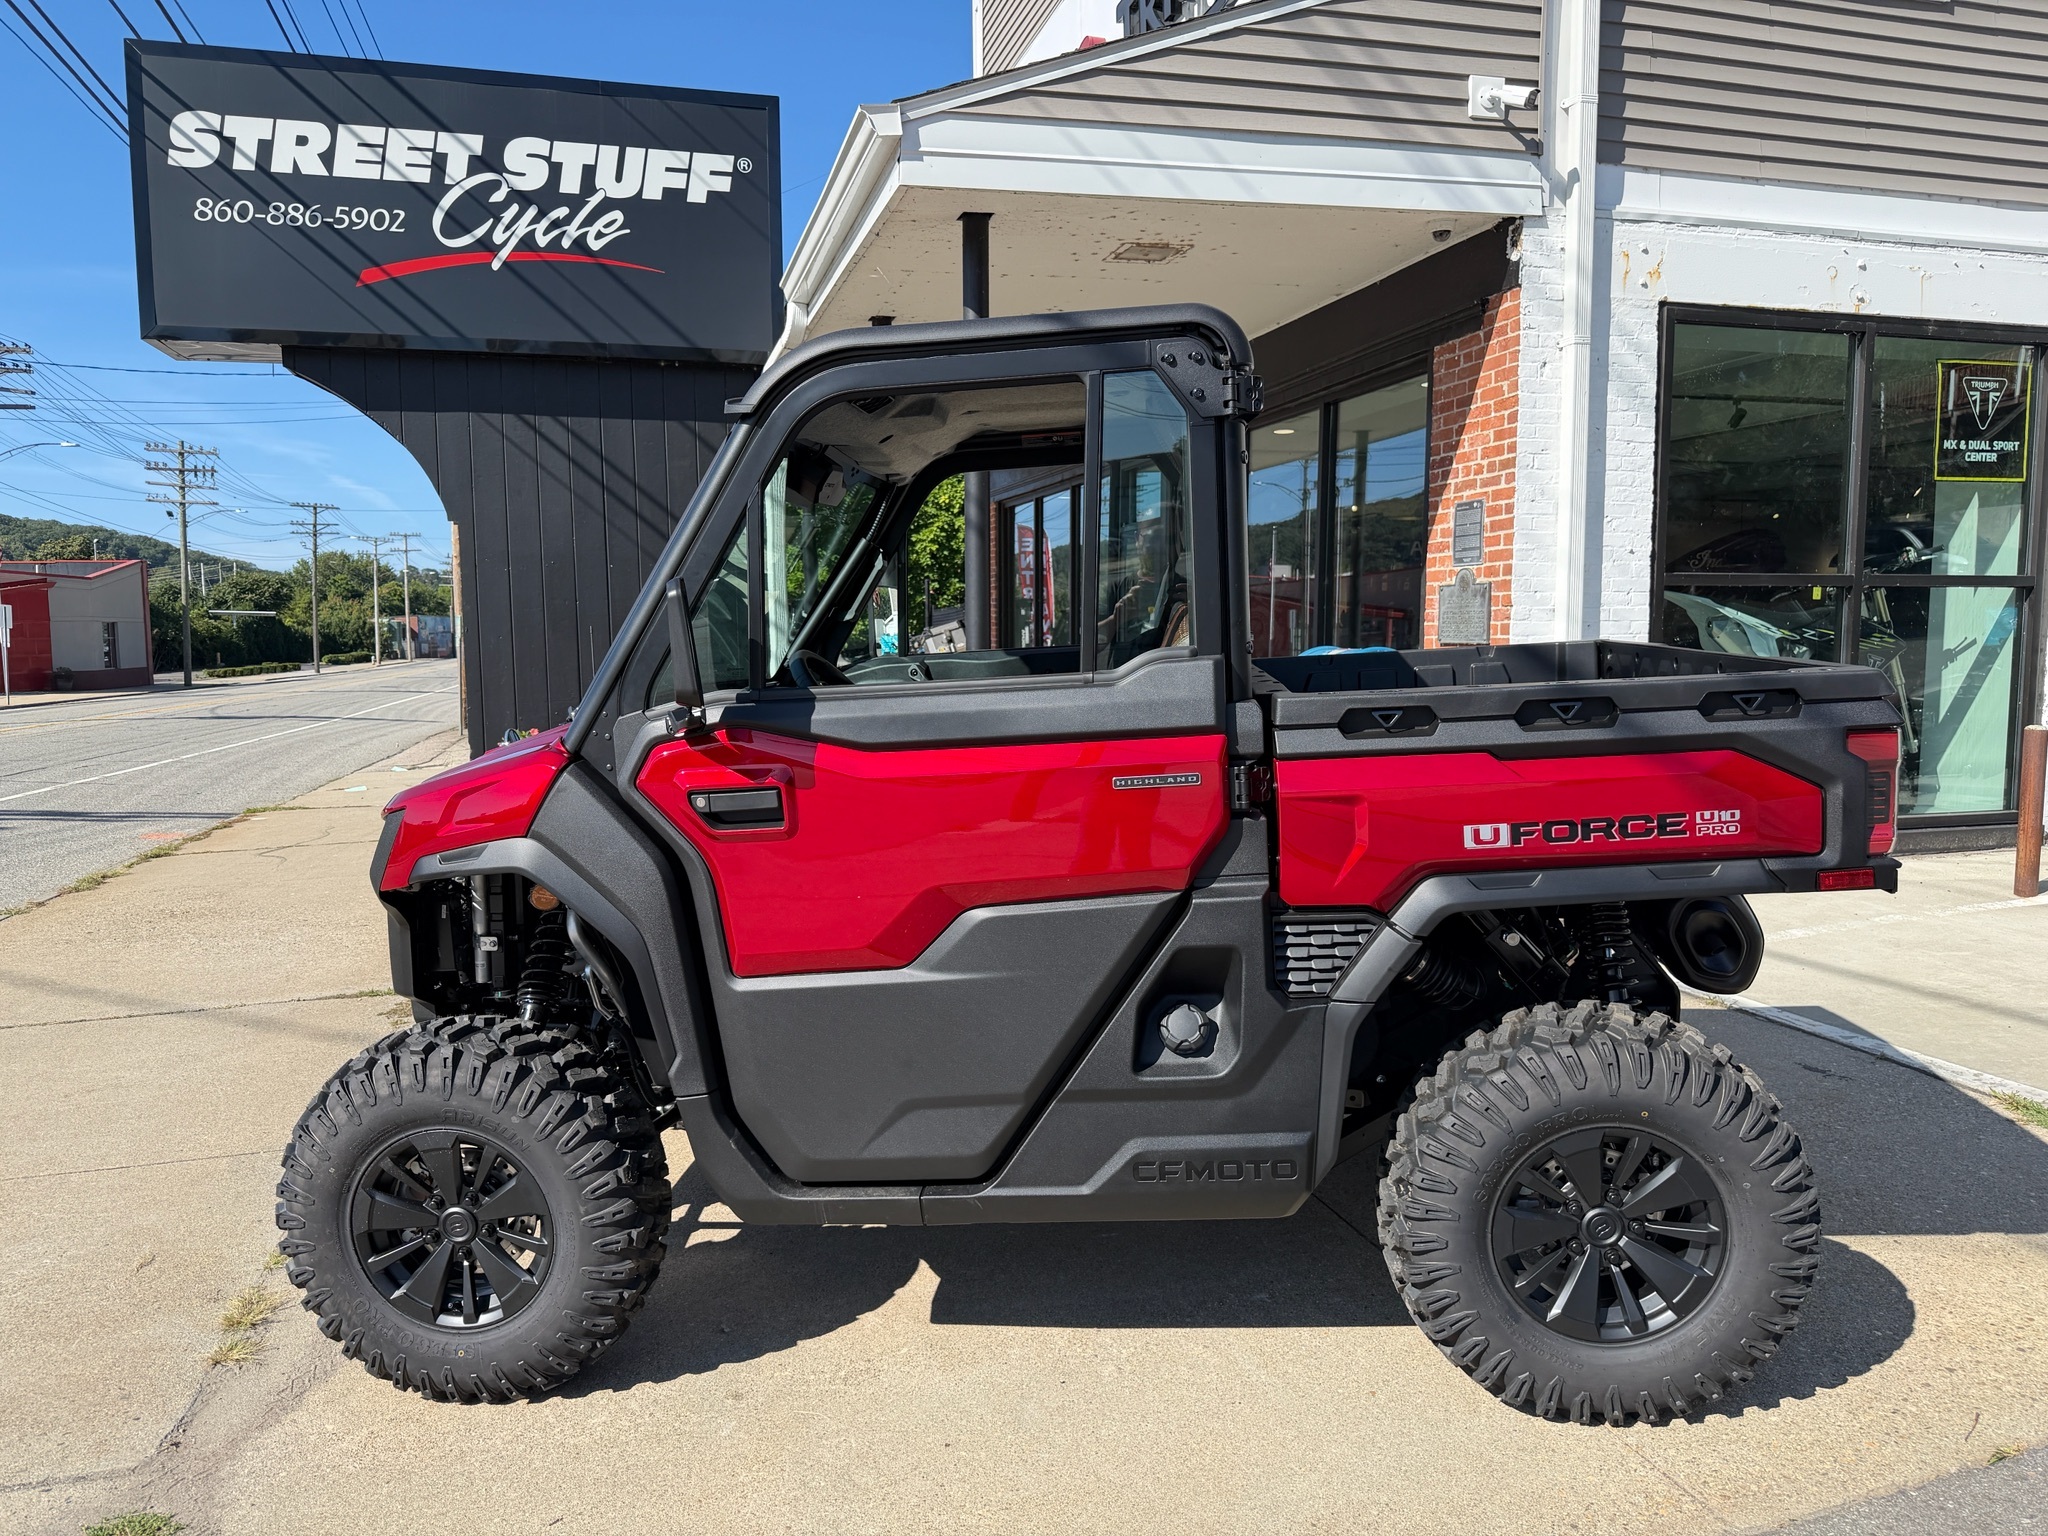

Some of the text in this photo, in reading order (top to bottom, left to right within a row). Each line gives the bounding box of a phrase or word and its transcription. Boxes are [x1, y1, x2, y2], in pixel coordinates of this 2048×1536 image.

[166, 110, 484, 185] STREET
[193, 196, 406, 234] 860-886-5902
[432, 172, 631, 271] Cycle
[1971, 380, 1999, 389] TRIUMPH
[1943, 440, 2020, 451] MX & DUAL SPORT
[1965, 452, 1998, 462] CENTER
[1116, 776, 1197, 786] HIGHLAND
[1696, 809, 1741, 823] U10
[1696, 823, 1741, 836] PRO
[439, 1106, 532, 1152] ARISUN
[1132, 1159, 1298, 1183] CFMOTO
